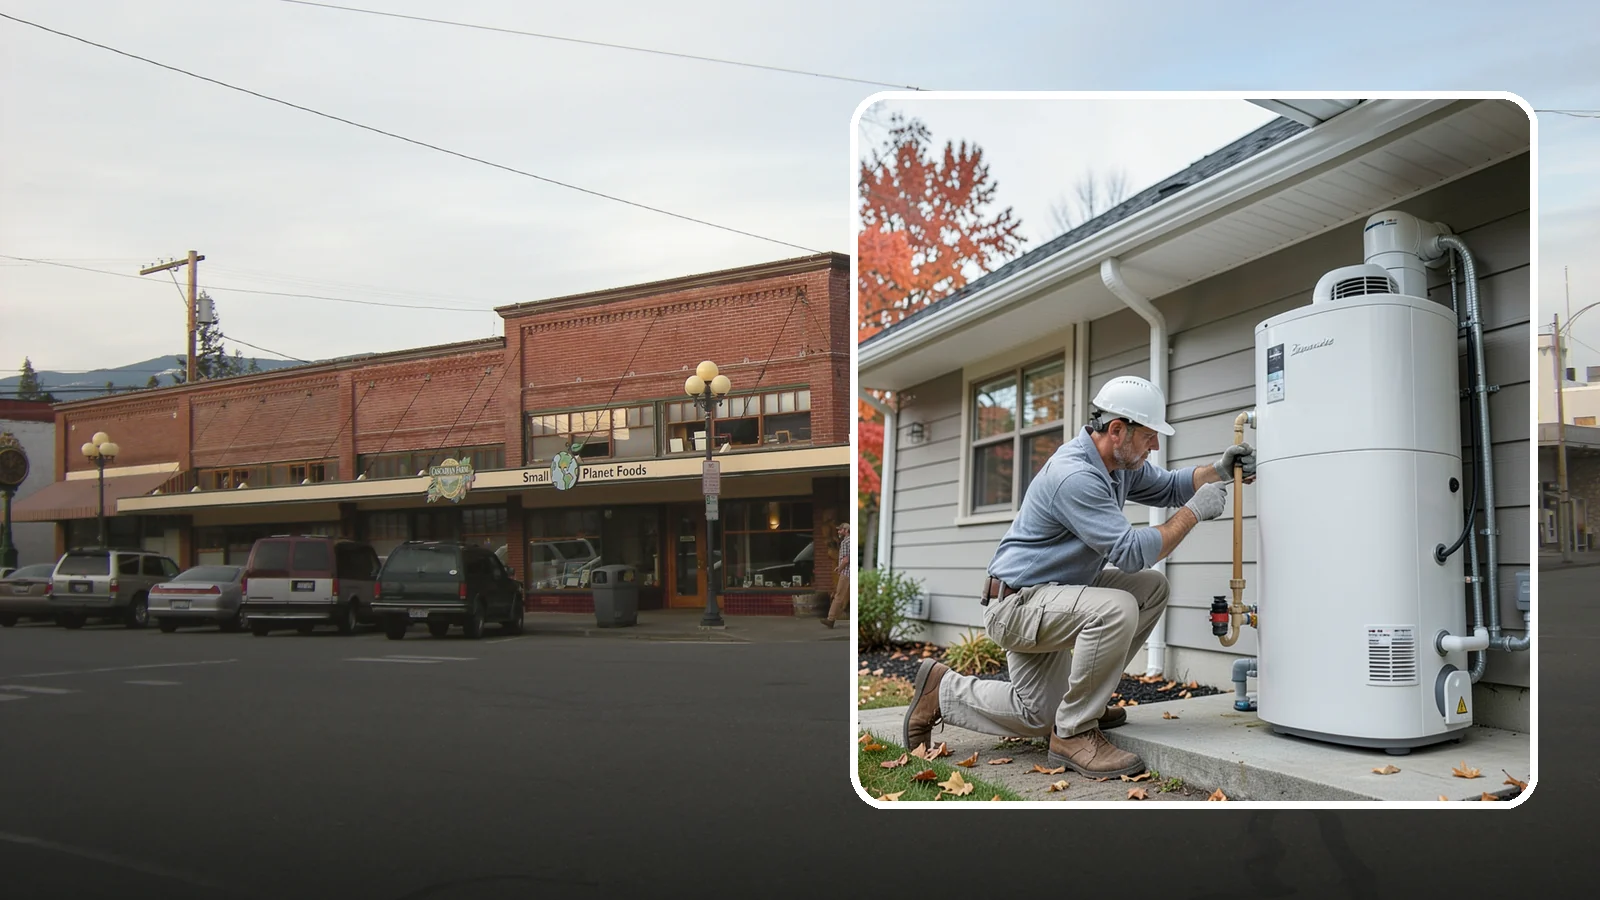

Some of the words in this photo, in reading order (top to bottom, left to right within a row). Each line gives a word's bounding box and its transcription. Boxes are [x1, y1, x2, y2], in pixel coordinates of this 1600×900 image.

[523, 471, 548, 482] Small
[582, 468, 614, 479] Planet
[617, 464, 647, 476] Foods
